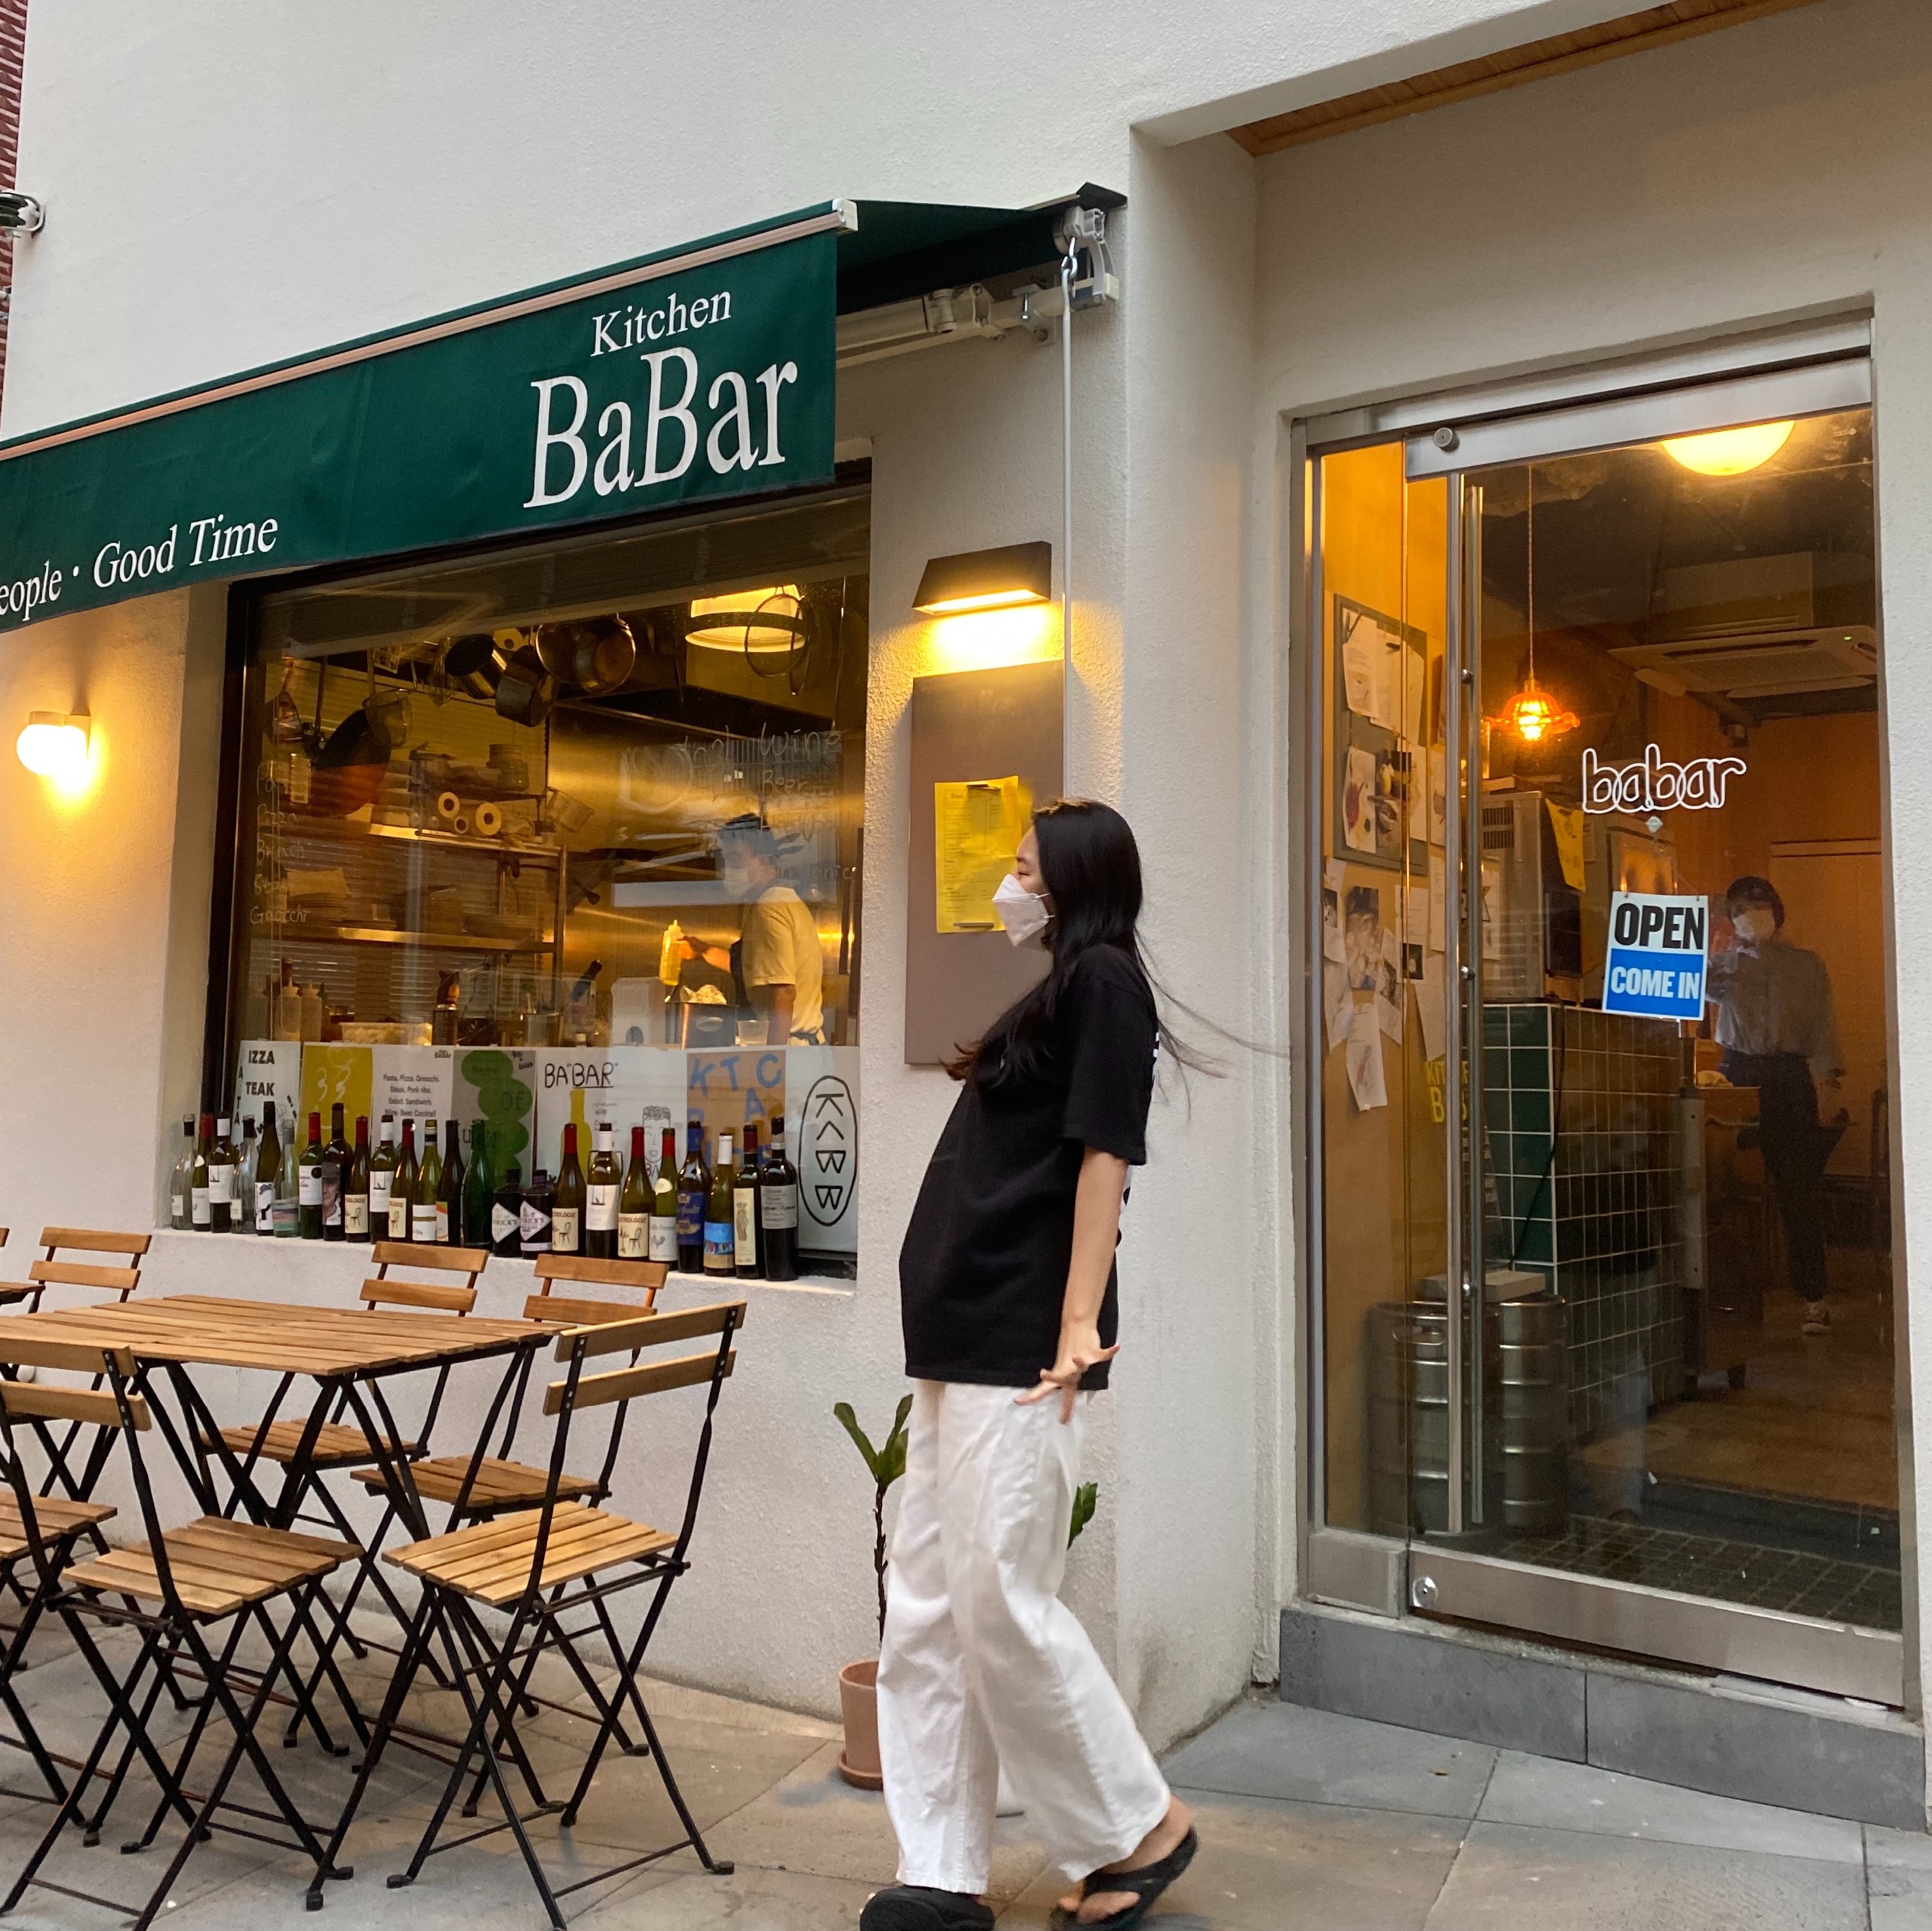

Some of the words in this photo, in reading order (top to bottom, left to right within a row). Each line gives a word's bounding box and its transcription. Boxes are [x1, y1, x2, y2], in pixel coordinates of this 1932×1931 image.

[591, 291, 732, 357] Kitchen
[523, 347, 798, 508] BaBar
[93, 524, 178, 588] Good
[189, 514, 279, 566] Time
[759, 722, 841, 758] Wine
[762, 770, 808, 796] Beer
[1582, 743, 1747, 814] babar
[1614, 903, 1705, 950] OPEN
[1610, 966, 1676, 998] COME
[1677, 971, 1700, 999] IN
